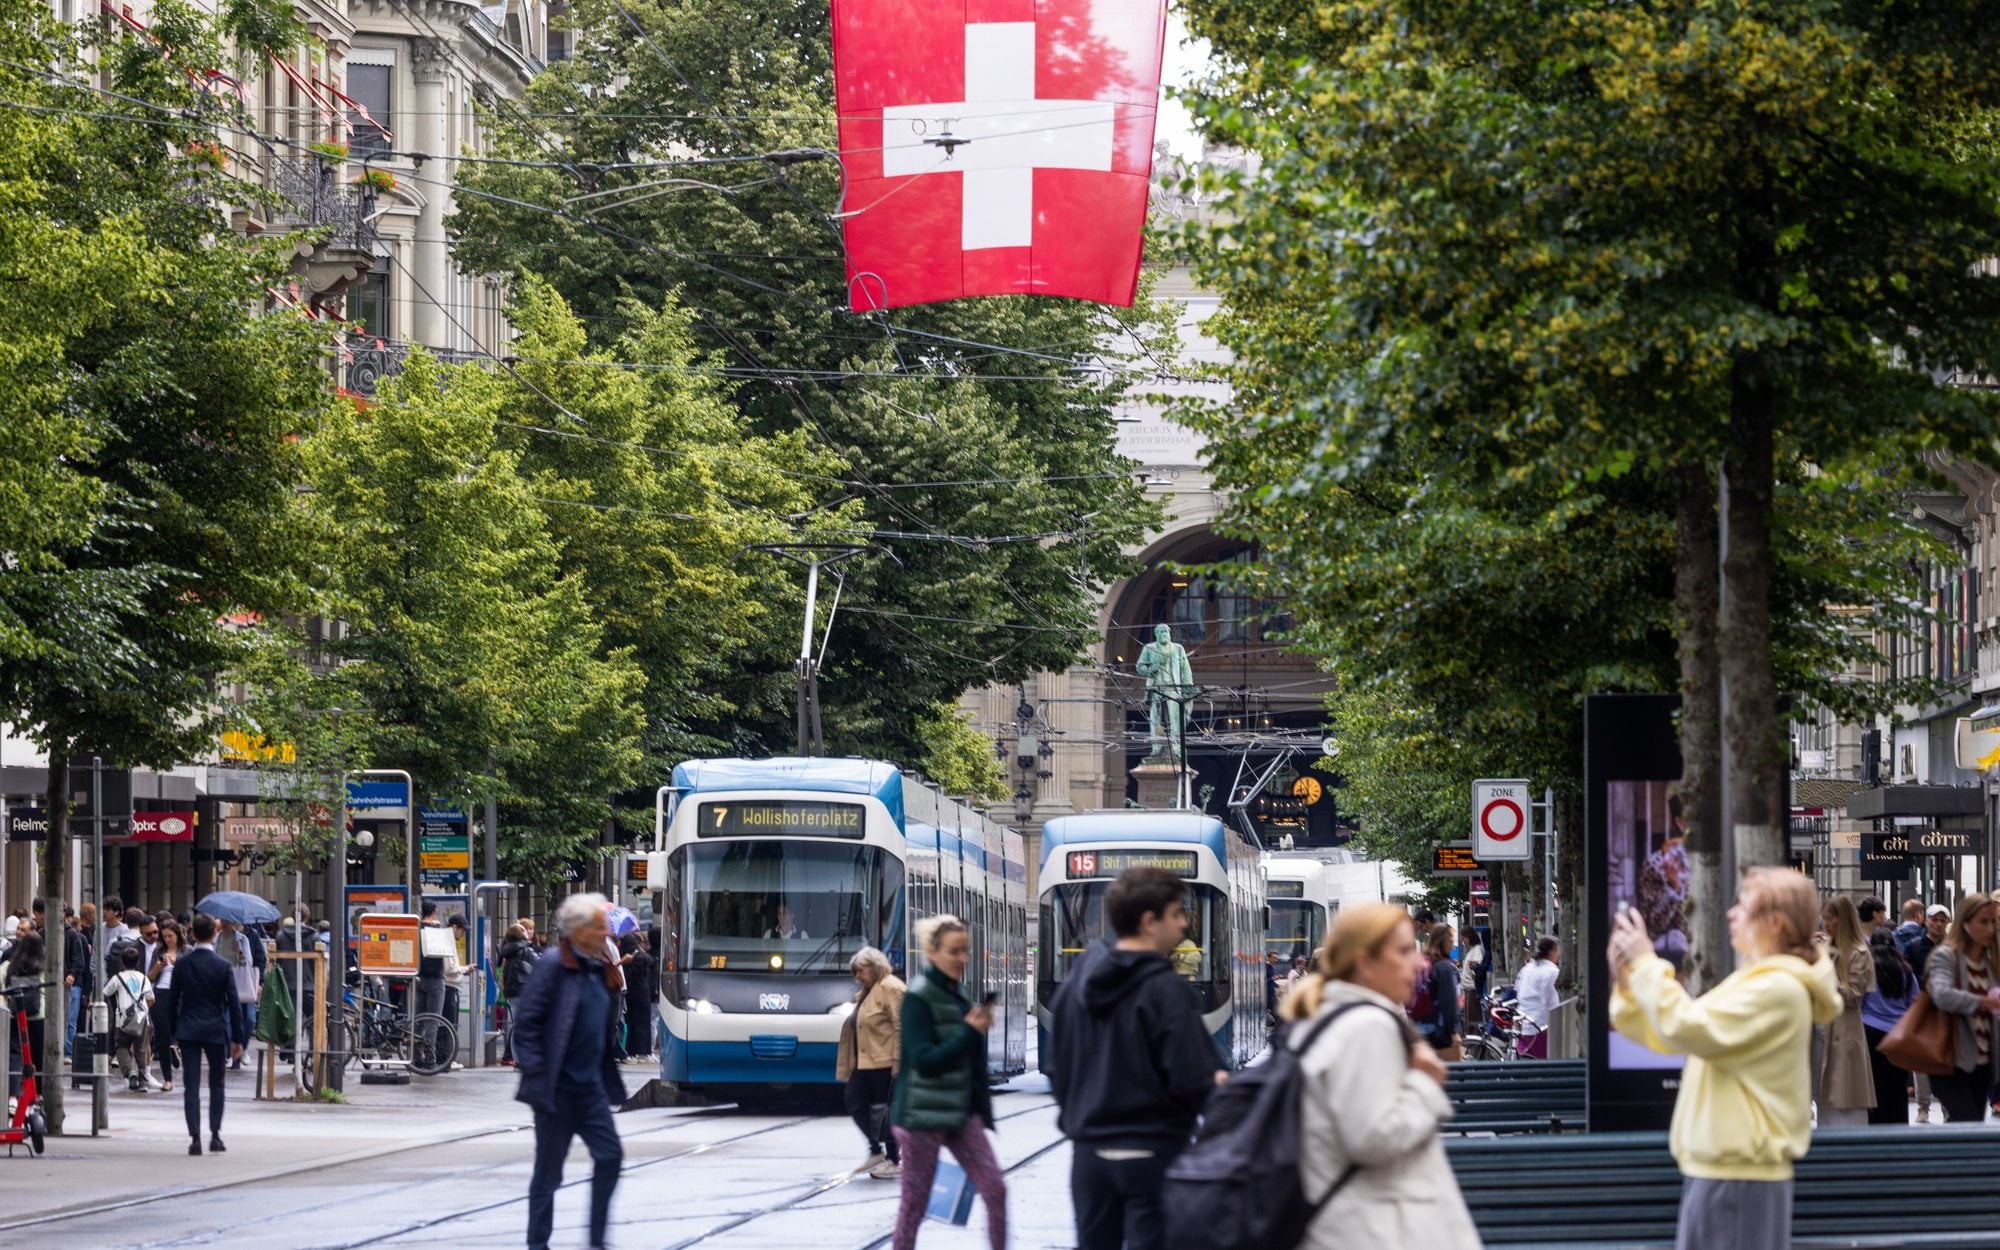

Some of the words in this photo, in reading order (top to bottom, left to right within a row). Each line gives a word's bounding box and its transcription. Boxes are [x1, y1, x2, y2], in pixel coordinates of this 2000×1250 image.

[1491, 788, 1514, 797] ZONE
[713, 807, 728, 828] 7
[743, 808, 858, 827] Wollishoferplatz
[1883, 836, 1909, 851] GÖT
[1921, 831, 1970, 848] GÖTTE
[1074, 855, 1094, 871] 15
[1103, 856, 1123, 870] Bhf.
